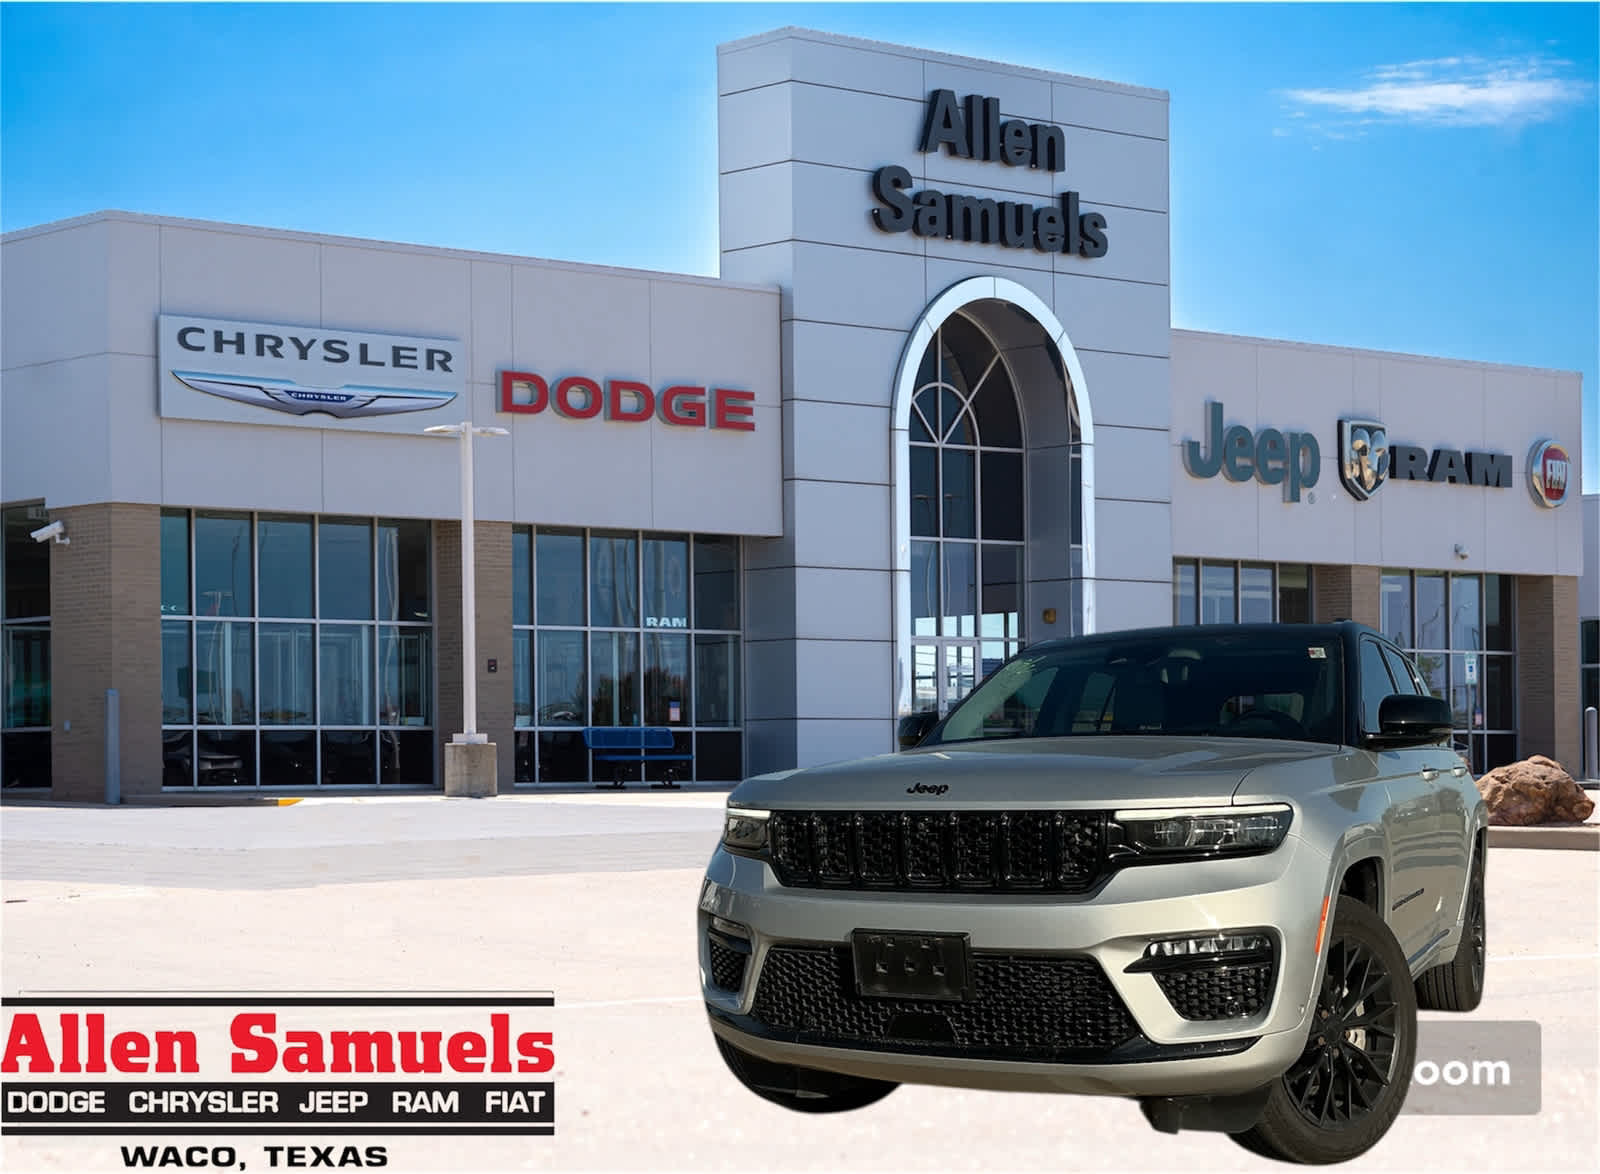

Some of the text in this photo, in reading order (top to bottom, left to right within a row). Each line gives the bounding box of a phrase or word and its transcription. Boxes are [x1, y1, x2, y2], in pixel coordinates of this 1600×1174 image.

[919, 89, 1066, 173] Allen
[872, 165, 1108, 258] Samuels
[177, 326, 454, 374] CHRYSLER
[290, 392, 347, 401] CHRYSLER
[497, 369, 756, 432] DODGE
[1183, 400, 1321, 503] Jeep
[1389, 445, 1513, 488] RAM
[1545, 458, 1567, 490] FIAT
[645, 616, 687, 628] RAM
[906, 782, 949, 796] Jeep
